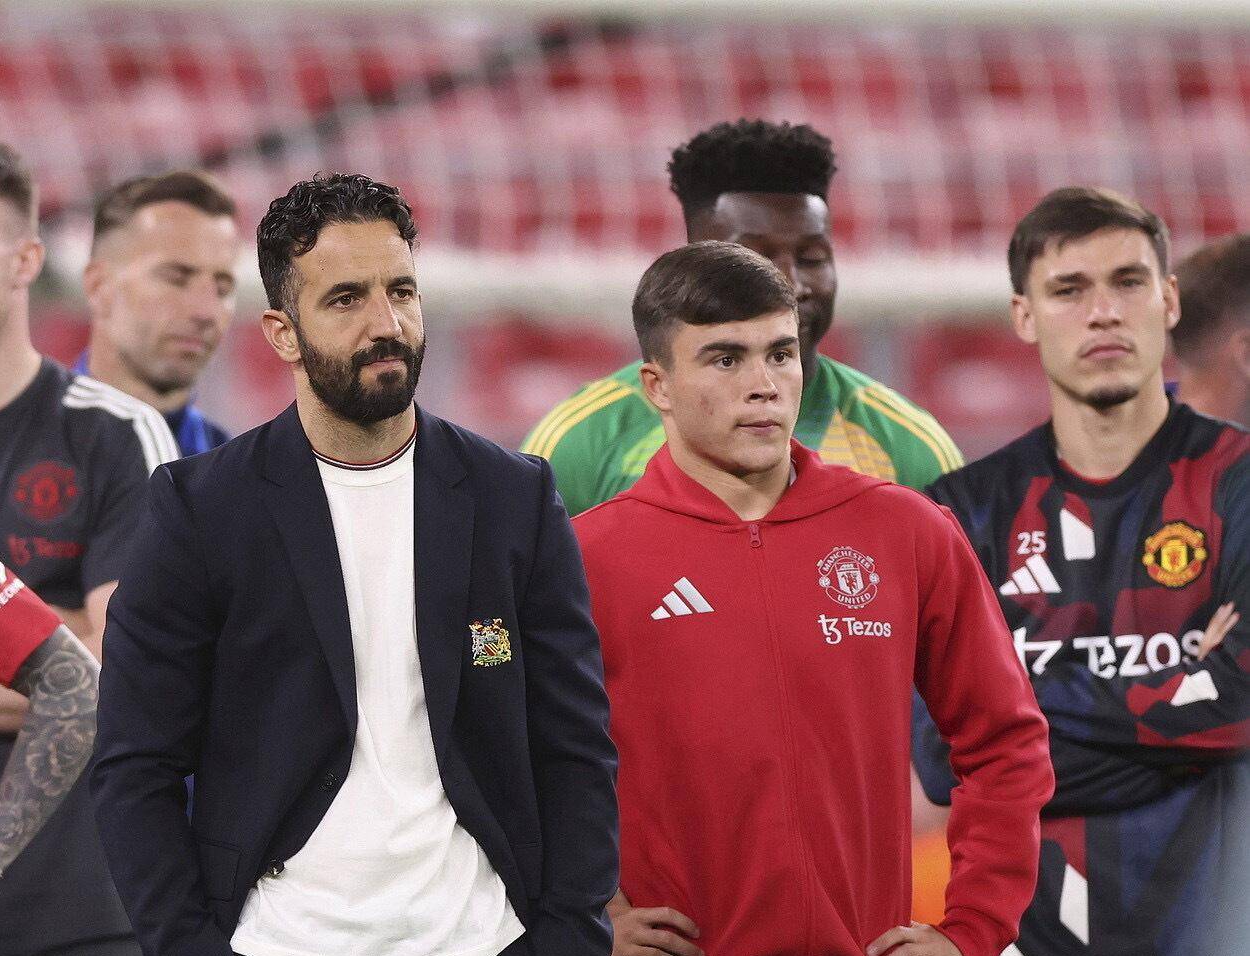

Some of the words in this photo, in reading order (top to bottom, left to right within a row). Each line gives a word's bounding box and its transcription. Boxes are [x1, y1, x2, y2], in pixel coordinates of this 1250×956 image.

[1016, 530, 1047, 555] 25
[822, 551, 872, 573] MANCHESTER
[837, 592, 872, 605] UNITED
[841, 616, 892, 638] Tezos
